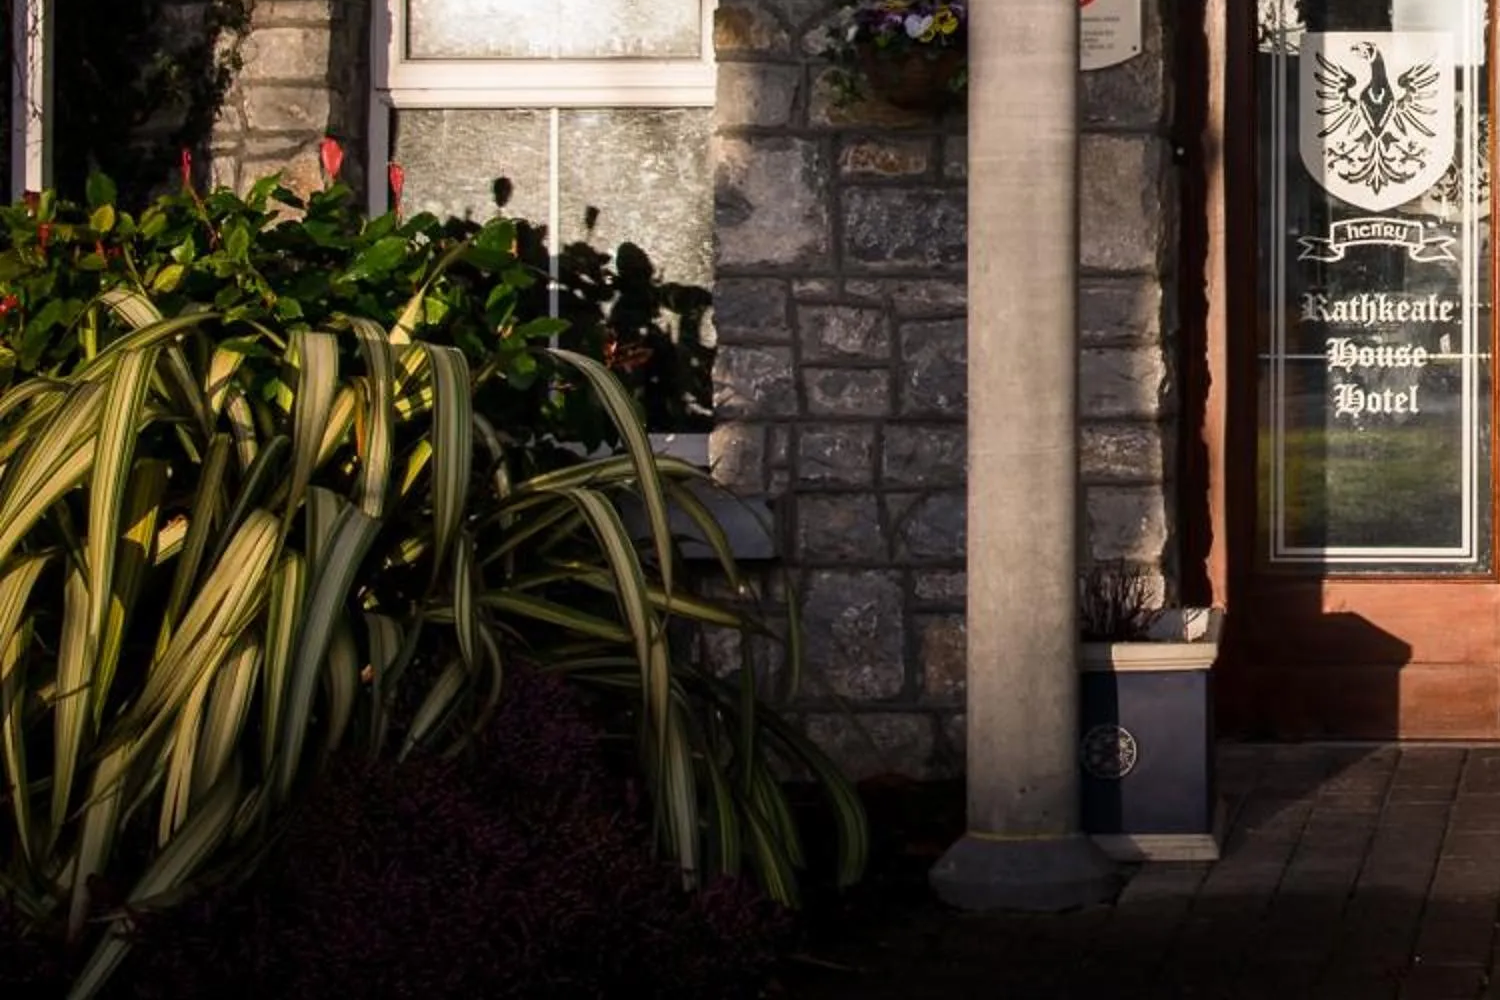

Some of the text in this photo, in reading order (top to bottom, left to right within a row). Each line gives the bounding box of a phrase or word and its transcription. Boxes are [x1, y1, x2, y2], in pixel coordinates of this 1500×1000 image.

[1302, 293, 1453, 327] Rathkeale
[1326, 336, 1428, 373] House
[1332, 383, 1419, 418] Hotel
